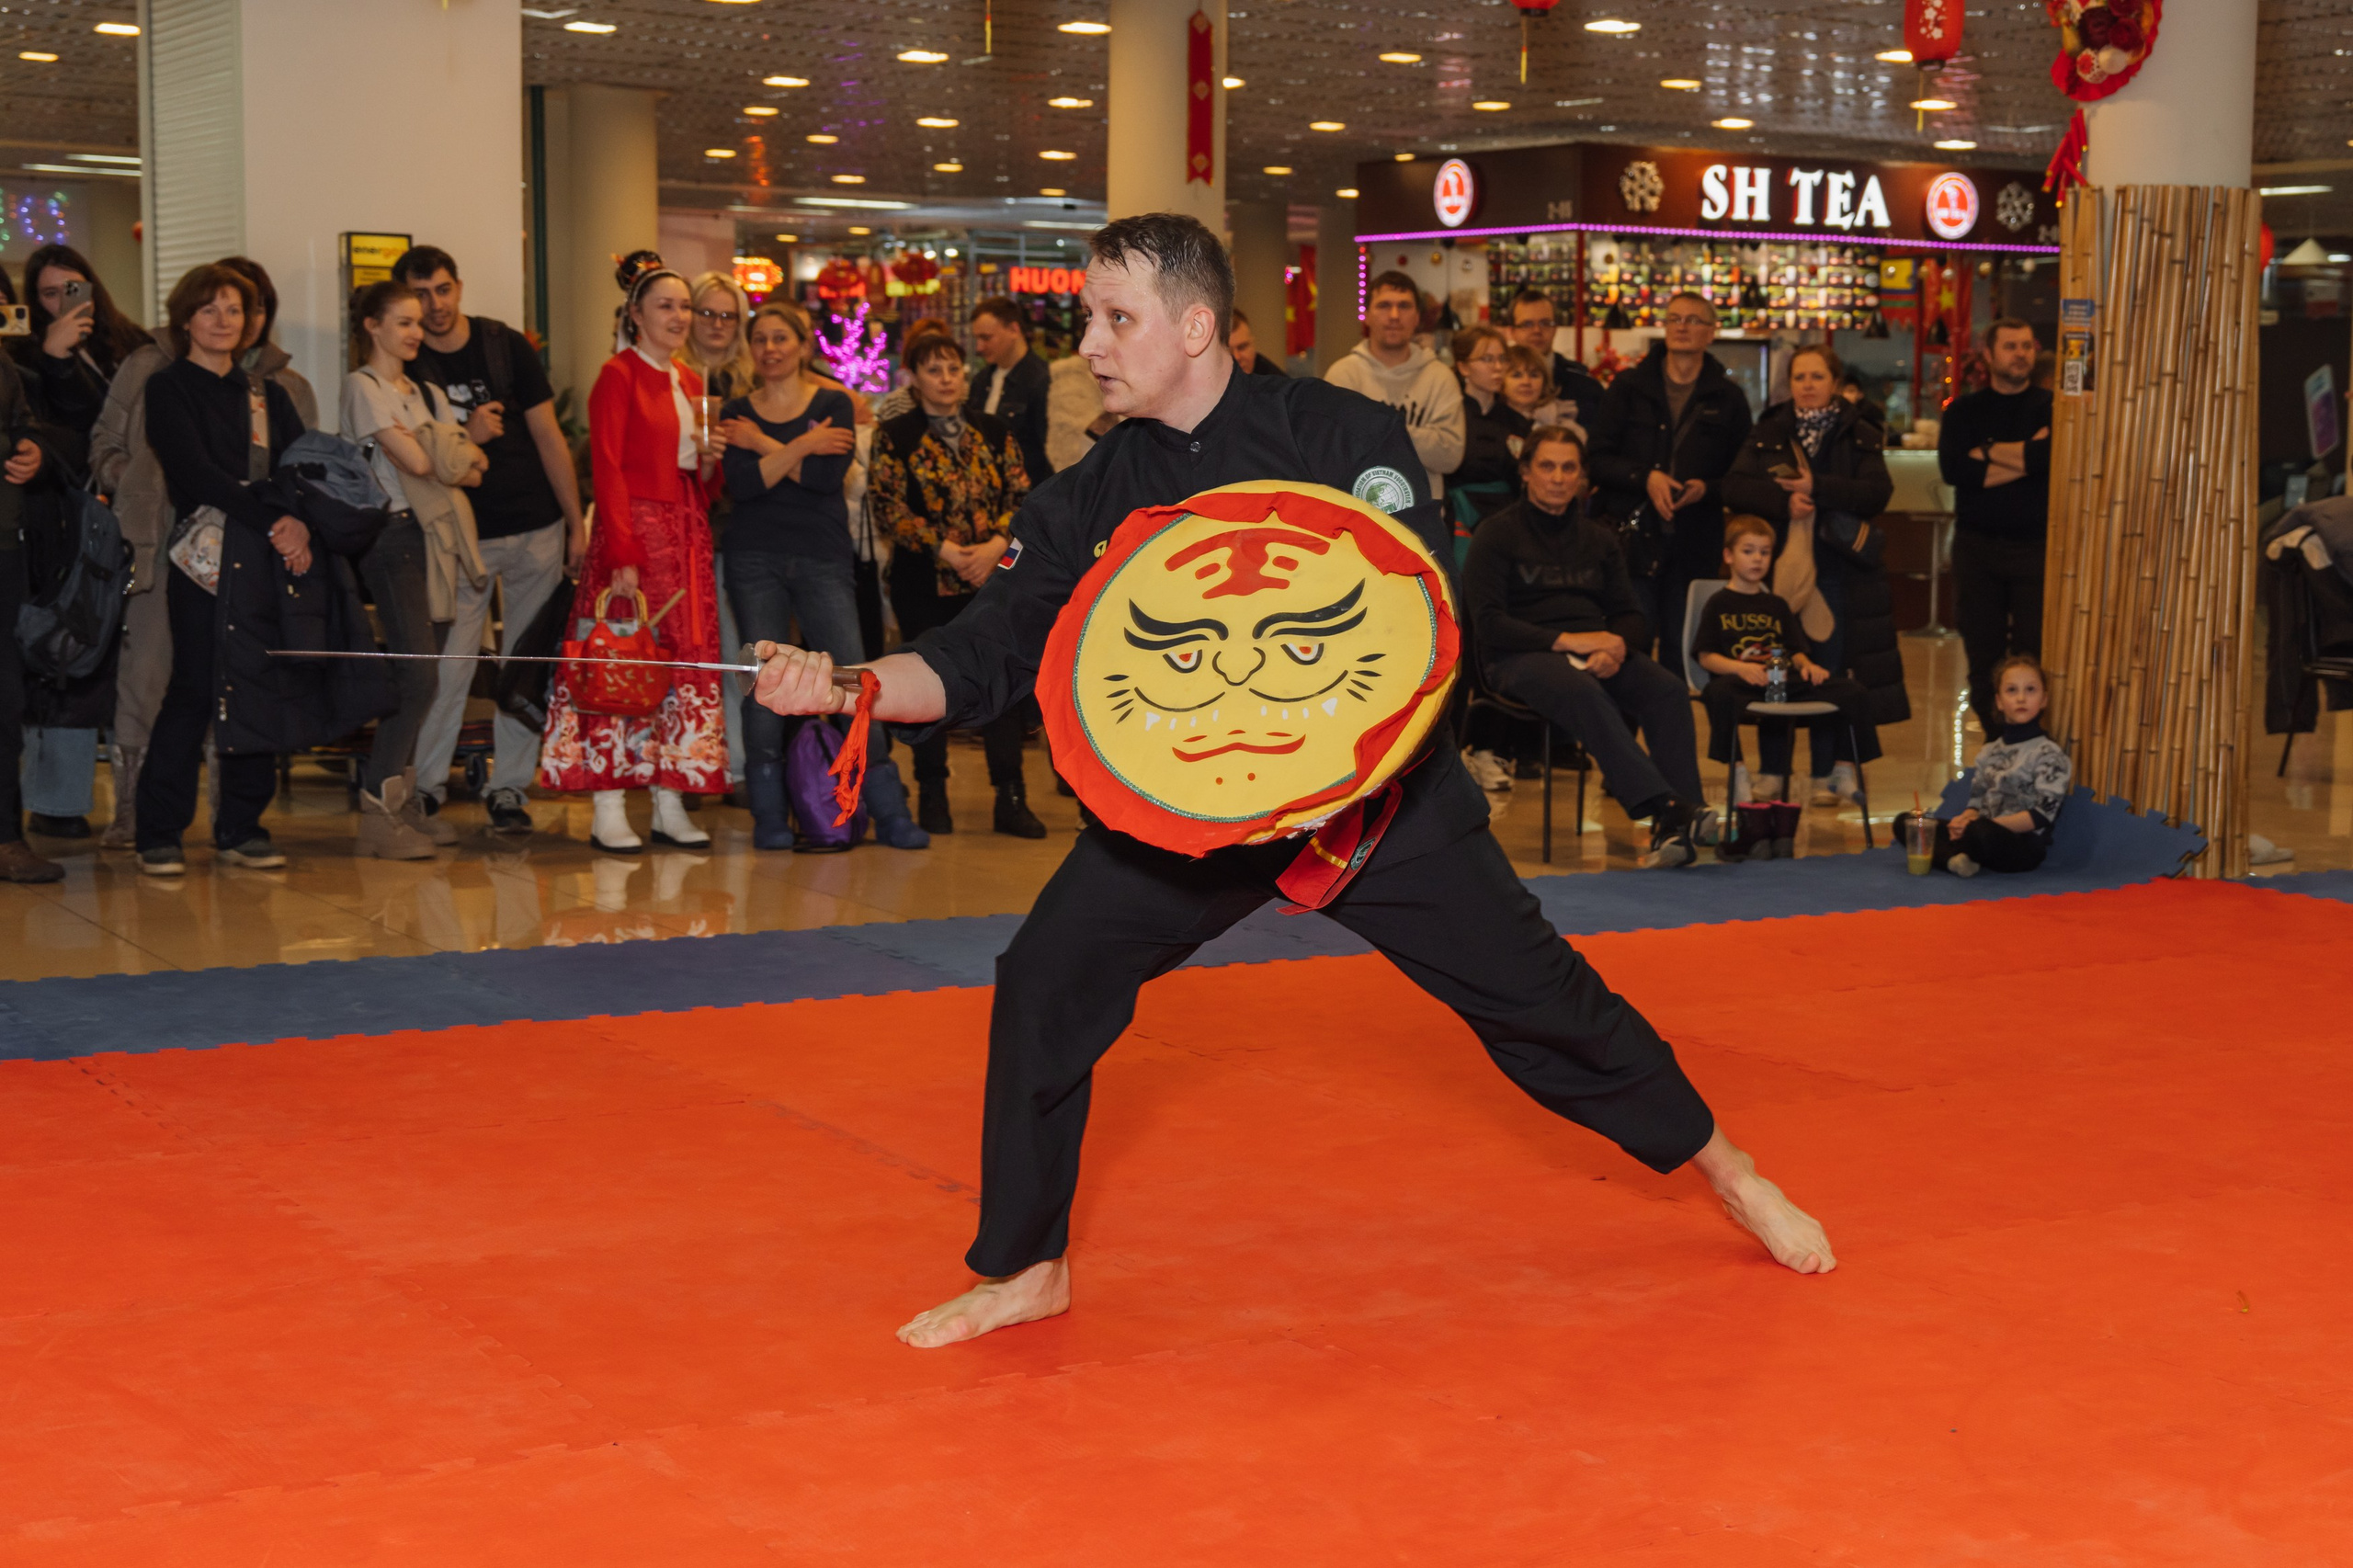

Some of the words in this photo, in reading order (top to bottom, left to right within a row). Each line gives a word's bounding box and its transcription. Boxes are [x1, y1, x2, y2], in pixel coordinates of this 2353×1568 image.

[1701, 164, 1771, 222] SH
[1790, 167, 1892, 231] TEA
[1365, 472, 1372, 480] OF
[1371, 469, 1394, 477] VIETNAM
[1720, 613, 1782, 634] RUSSIA
